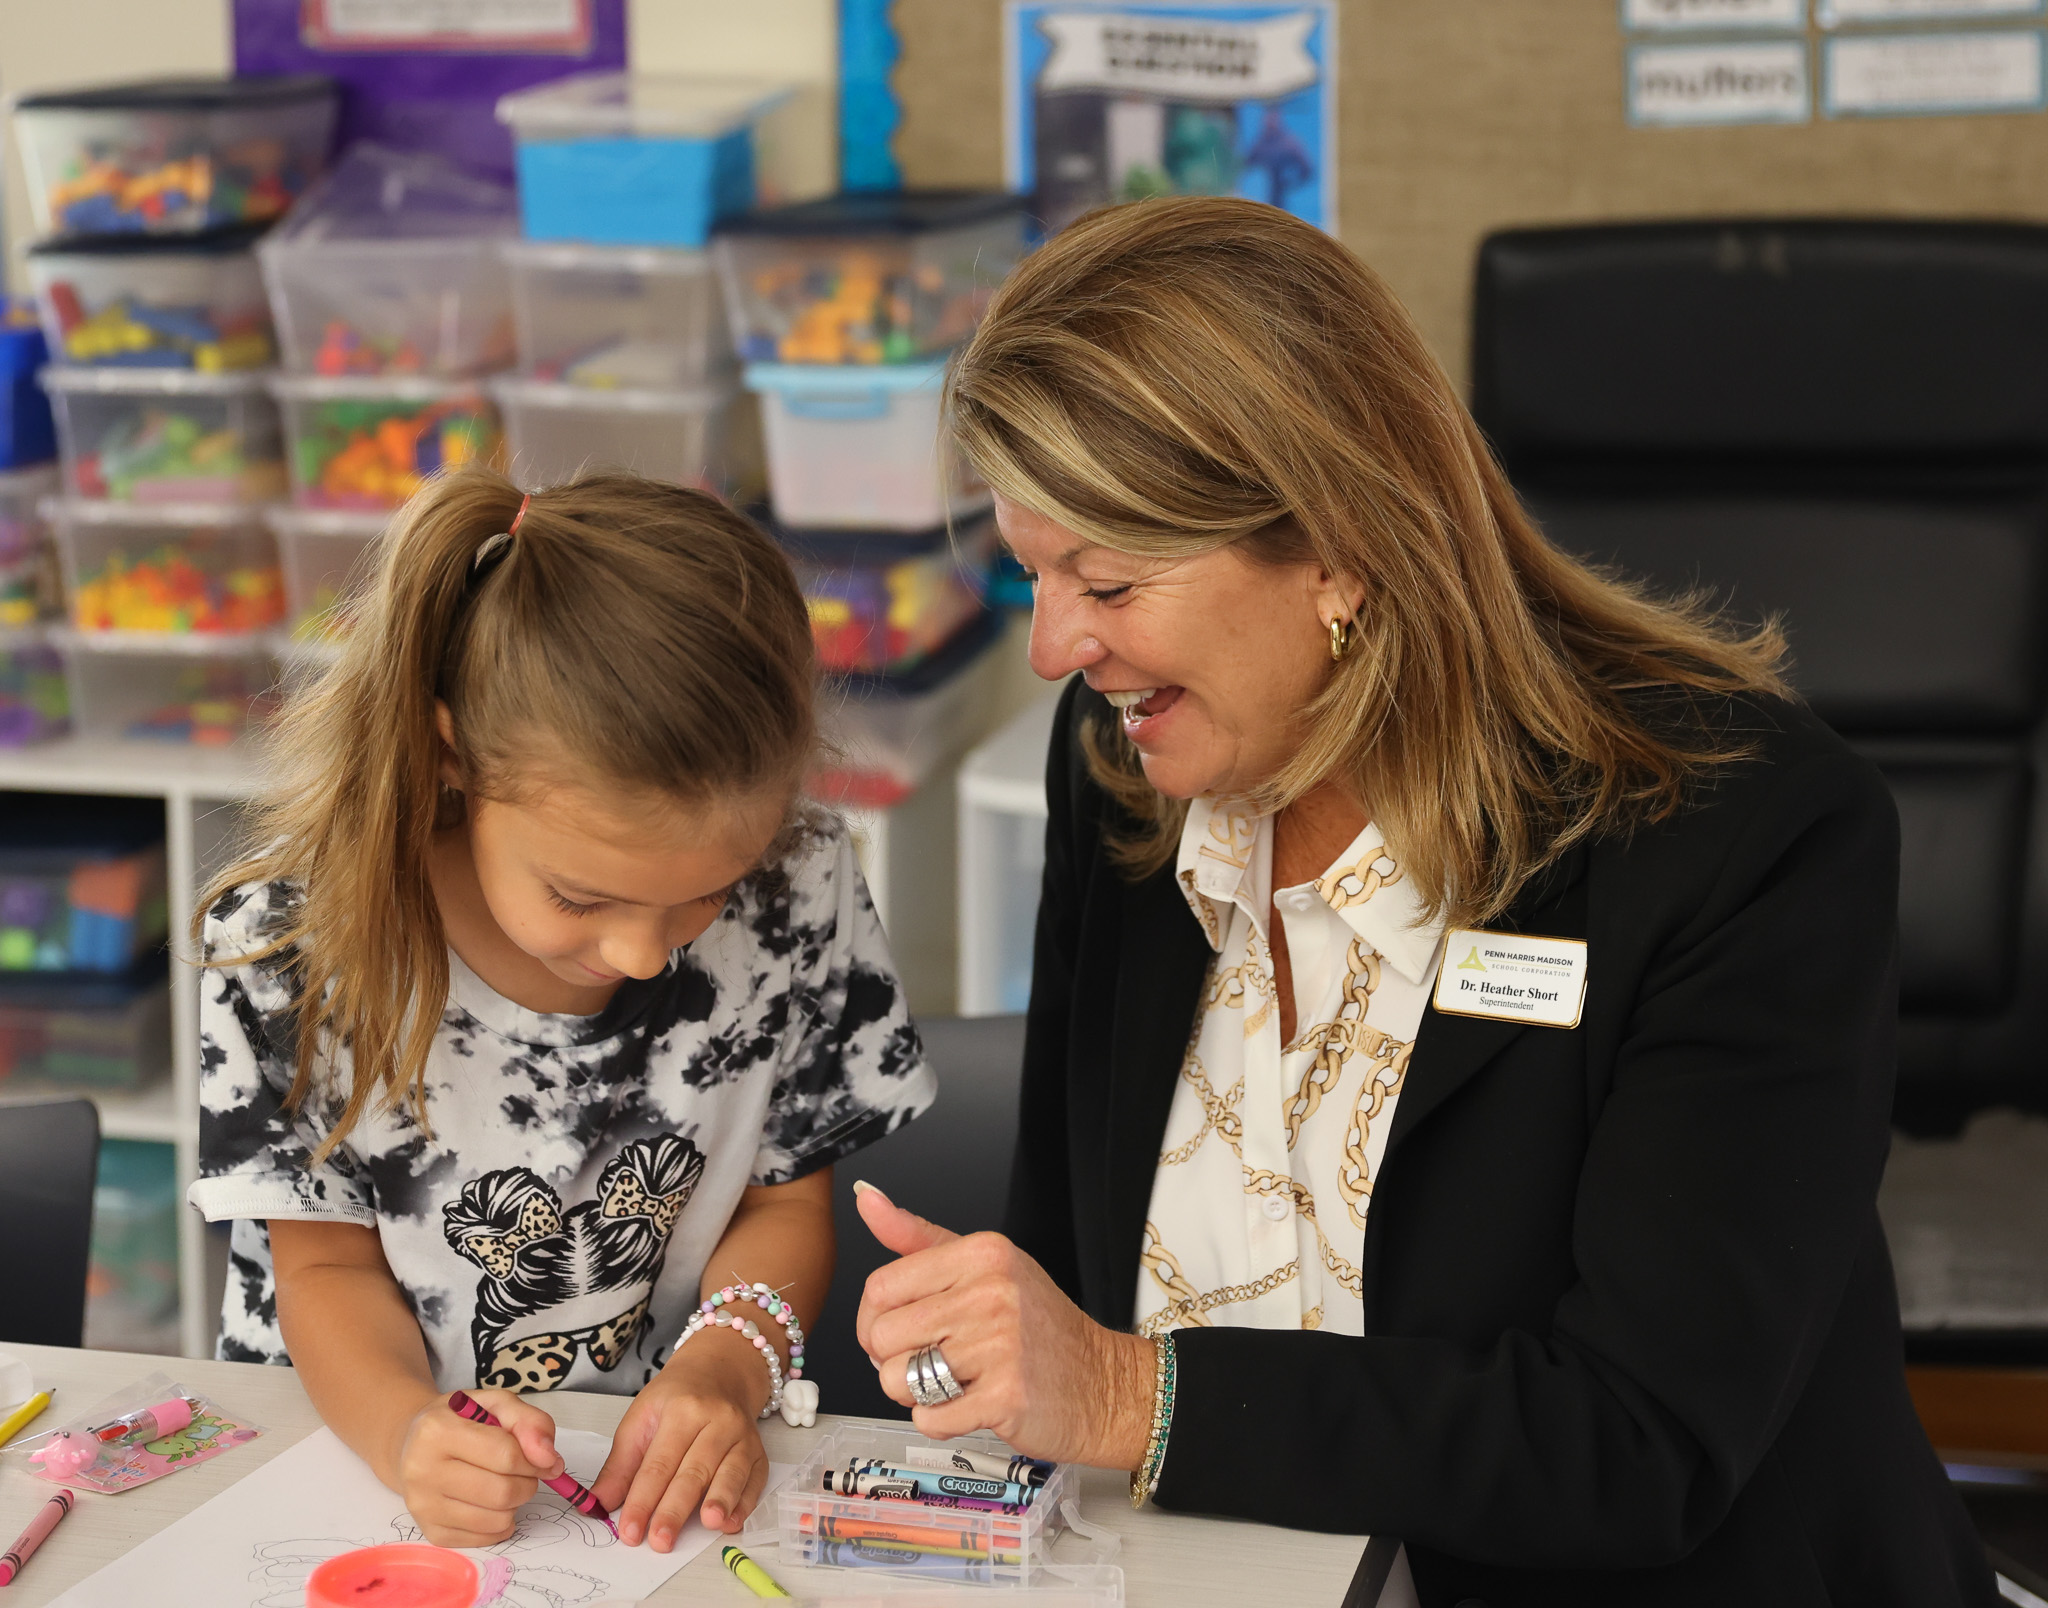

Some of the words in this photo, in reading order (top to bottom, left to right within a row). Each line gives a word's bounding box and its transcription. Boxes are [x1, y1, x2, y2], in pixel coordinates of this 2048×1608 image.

[1484, 949, 1506, 959] PENN
[1507, 952, 1536, 962] HARRIS
[1537, 956, 1574, 967] MADISON
[1491, 963, 1518, 972] SCHOOL
[1521, 967, 1572, 978] CORPORATION
[1460, 979, 1477, 992] Dr.
[1480, 981, 1525, 998] Heather
[1527, 987, 1559, 1002] Short
[1479, 996, 1534, 1011] Superintendent
[942, 1477, 998, 1494] Crayola
